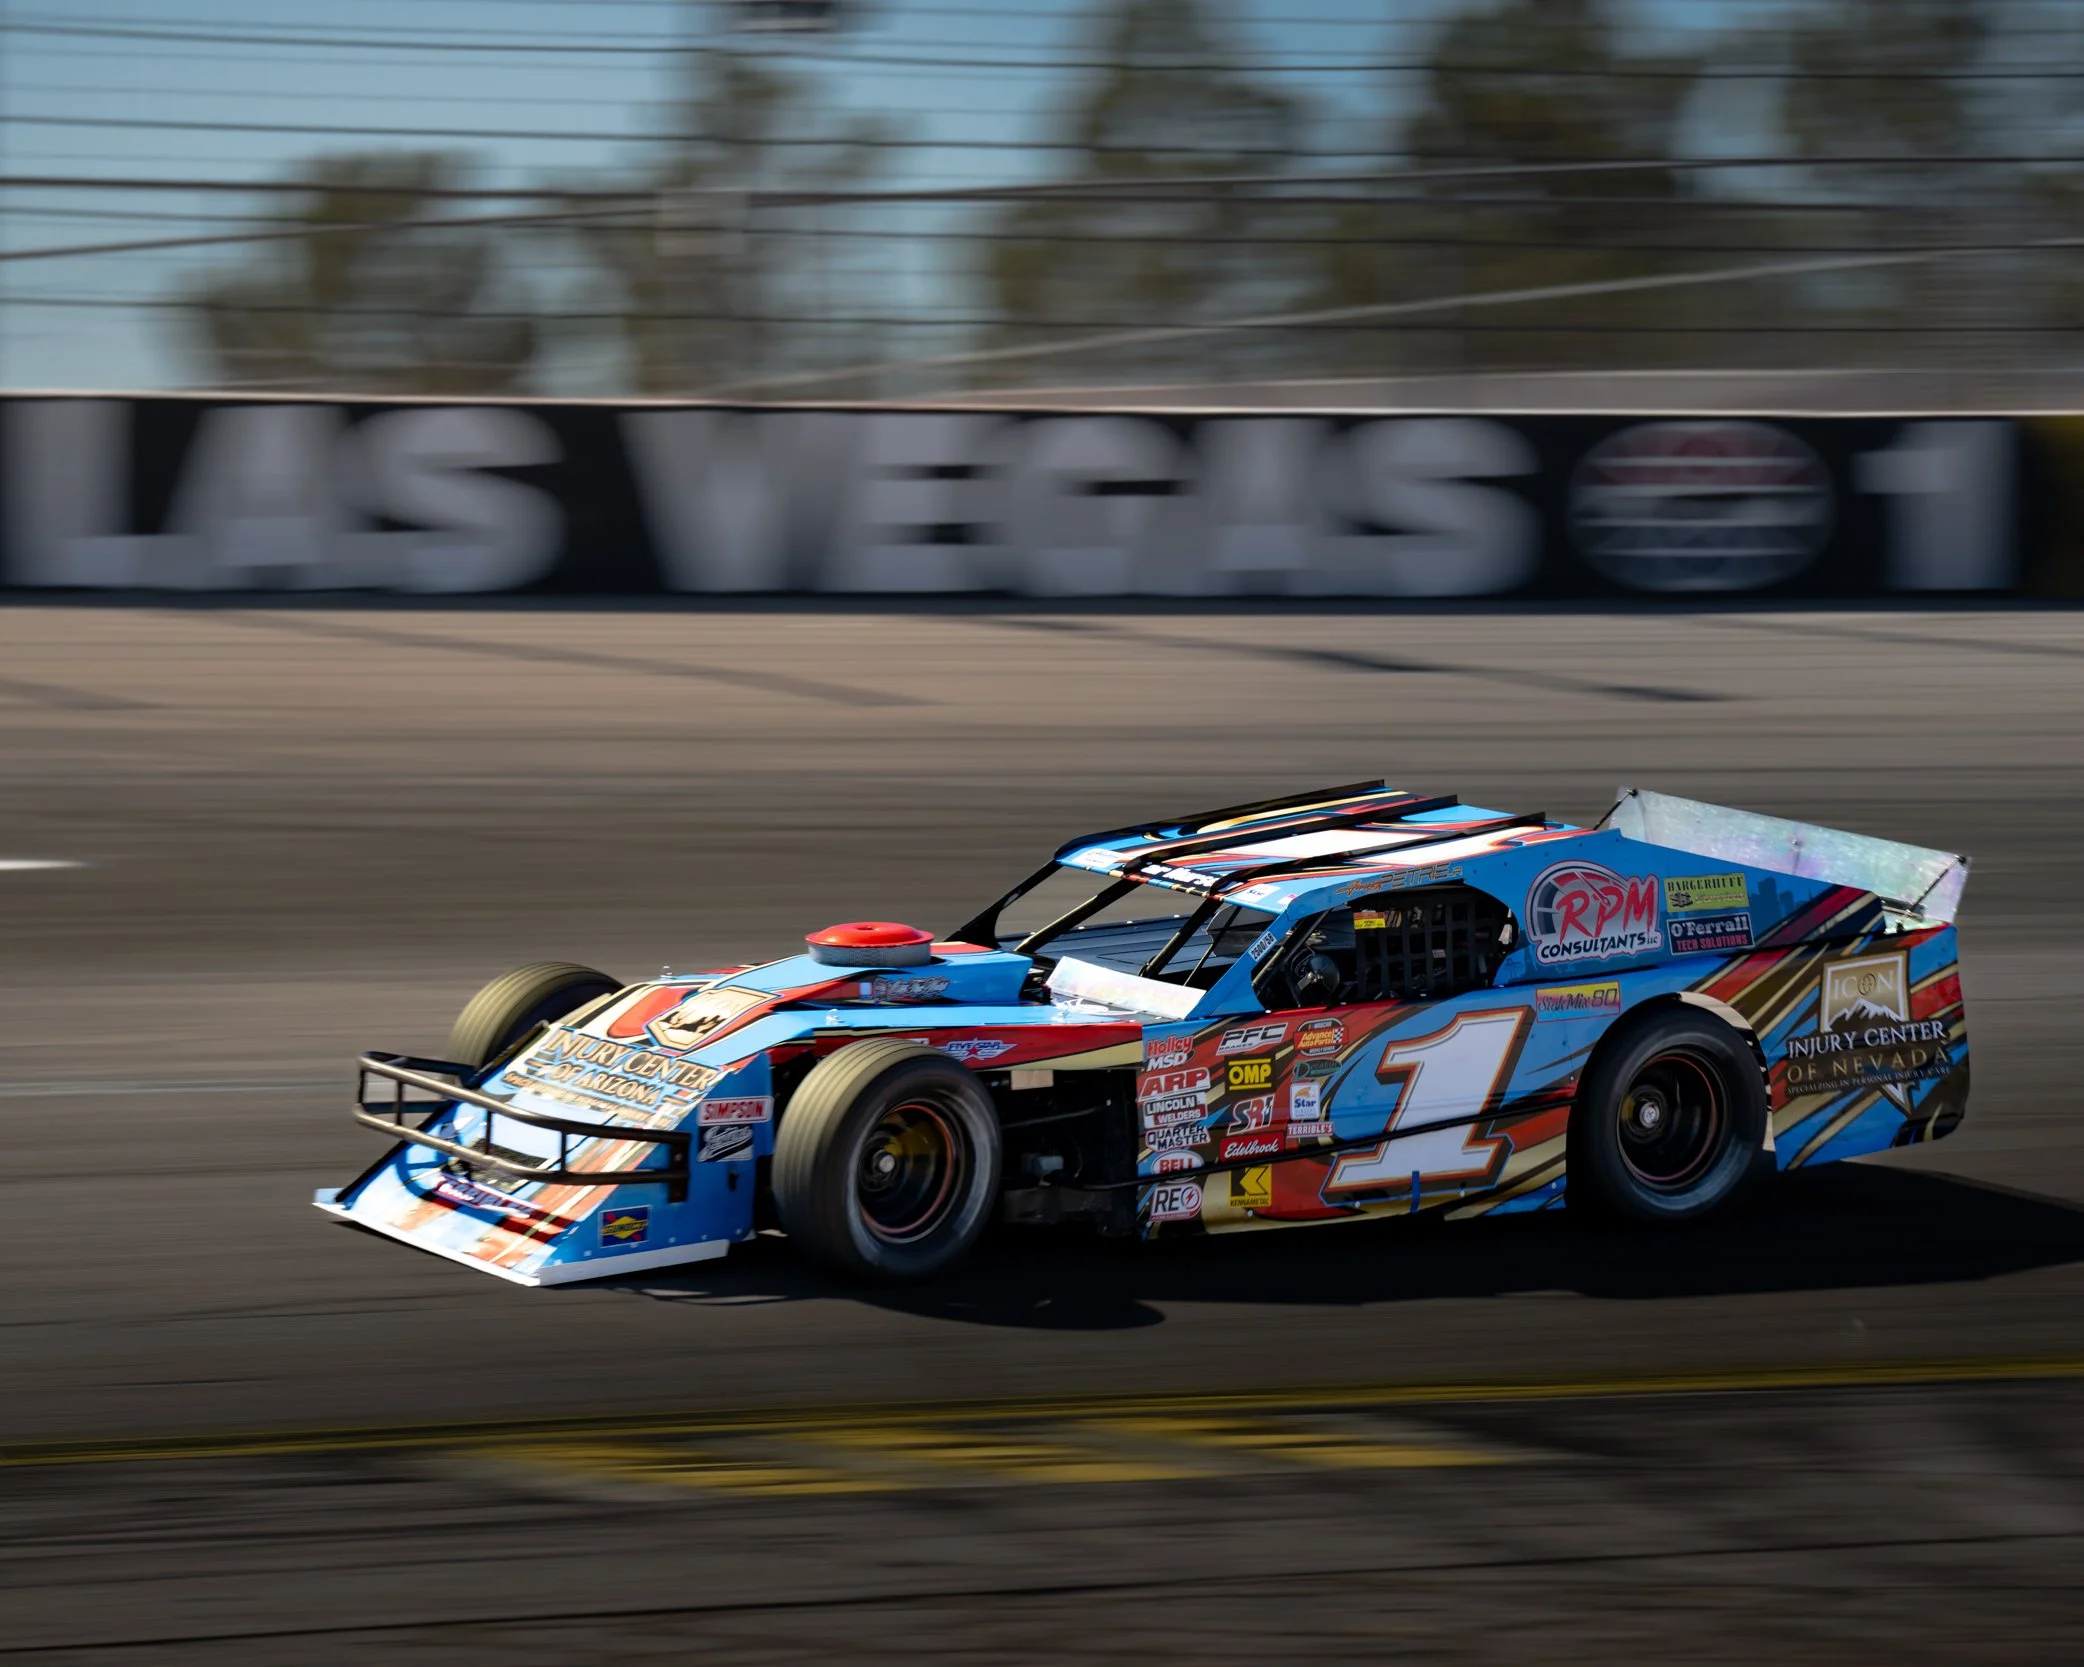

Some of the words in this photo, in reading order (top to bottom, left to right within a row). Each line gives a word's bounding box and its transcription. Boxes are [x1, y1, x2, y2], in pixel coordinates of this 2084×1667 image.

[2, 400, 567, 594] LAS
[615, 405, 1545, 600] VEGAS
[1855, 415, 2015, 592] 1
[1556, 880, 1655, 943] RPM
[1670, 916, 1749, 938] O'Ferrall
[1541, 932, 1646, 958] CONSULTANTS
[1676, 939, 1699, 951] TECH
[1701, 934, 1748, 949] SOLUTIONS
[1221, 1023, 1287, 1046] PFC
[1298, 1039, 1314, 1048] Auto
[1302, 1030, 1333, 1041] Advance
[1788, 1031, 1858, 1059] INJURY
[1864, 1020, 1948, 1047] CENTER
[948, 1042, 973, 1051] FIVE
[1147, 1035, 1193, 1057] Holley
[545, 1029, 624, 1068] INJURY
[623, 1049, 721, 1091] CENTER
[1147, 1052, 1188, 1071] MSD
[1787, 1064, 1817, 1083] OF
[1833, 1046, 1949, 1077] NEVADA
[550, 1063, 581, 1082] OF
[576, 1070, 664, 1106] ARIZONA
[1142, 1070, 1209, 1096] ARP
[1228, 1064, 1271, 1085] OMP
[704, 1101, 763, 1120] SIMPSON
[1147, 1096, 1196, 1115] LINCOLN
[1294, 1098, 1316, 1108] Star
[1321, 1006, 1535, 1200] 1
[1157, 1110, 1201, 1124] WELDERS
[1147, 1126, 1205, 1145] QUARTER
[1288, 1124, 1333, 1136] TERRIBLE'S
[1158, 1134, 1208, 1151] MASTER
[1224, 1138, 1279, 1158] Edelbrock
[1230, 1198, 1269, 1207] KENNAMETAL
